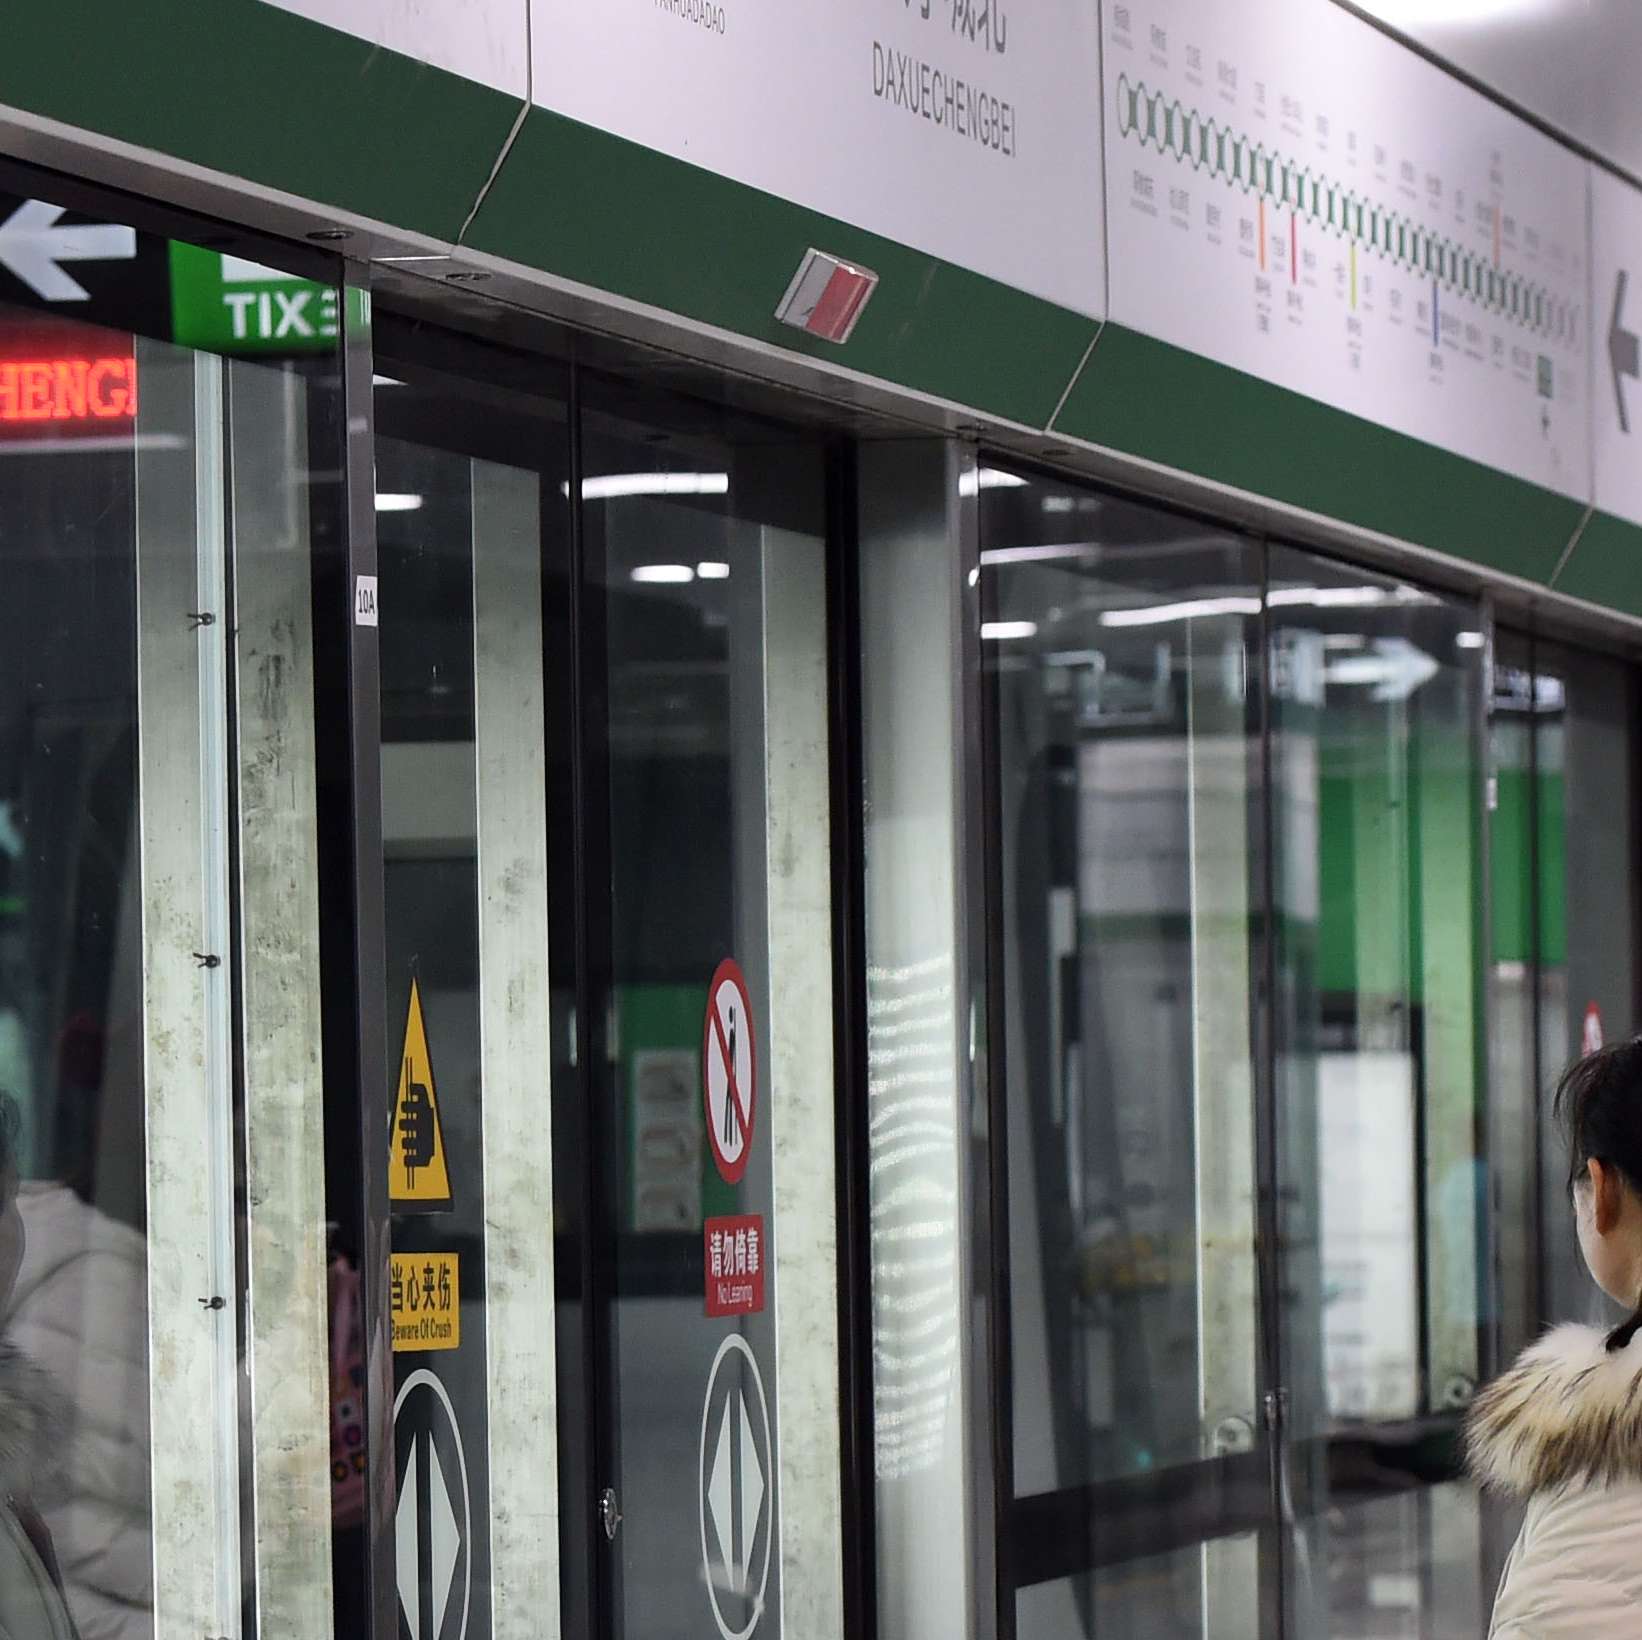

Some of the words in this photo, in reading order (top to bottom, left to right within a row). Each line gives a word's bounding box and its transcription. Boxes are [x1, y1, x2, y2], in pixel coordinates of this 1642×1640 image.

[654, 0, 726, 35] HUADADAO
[872, 40, 1017, 158] DAXUECHENGBEI
[358, 588, 376, 615] 10A
[709, 1226, 759, 1278] 请勿倚靠
[392, 1261, 451, 1313] 当心夹伤
[718, 1282, 727, 1305] No
[391, 1319, 419, 1341] Beware
[420, 1317, 429, 1340] Of
[430, 1316, 452, 1339] Crush
